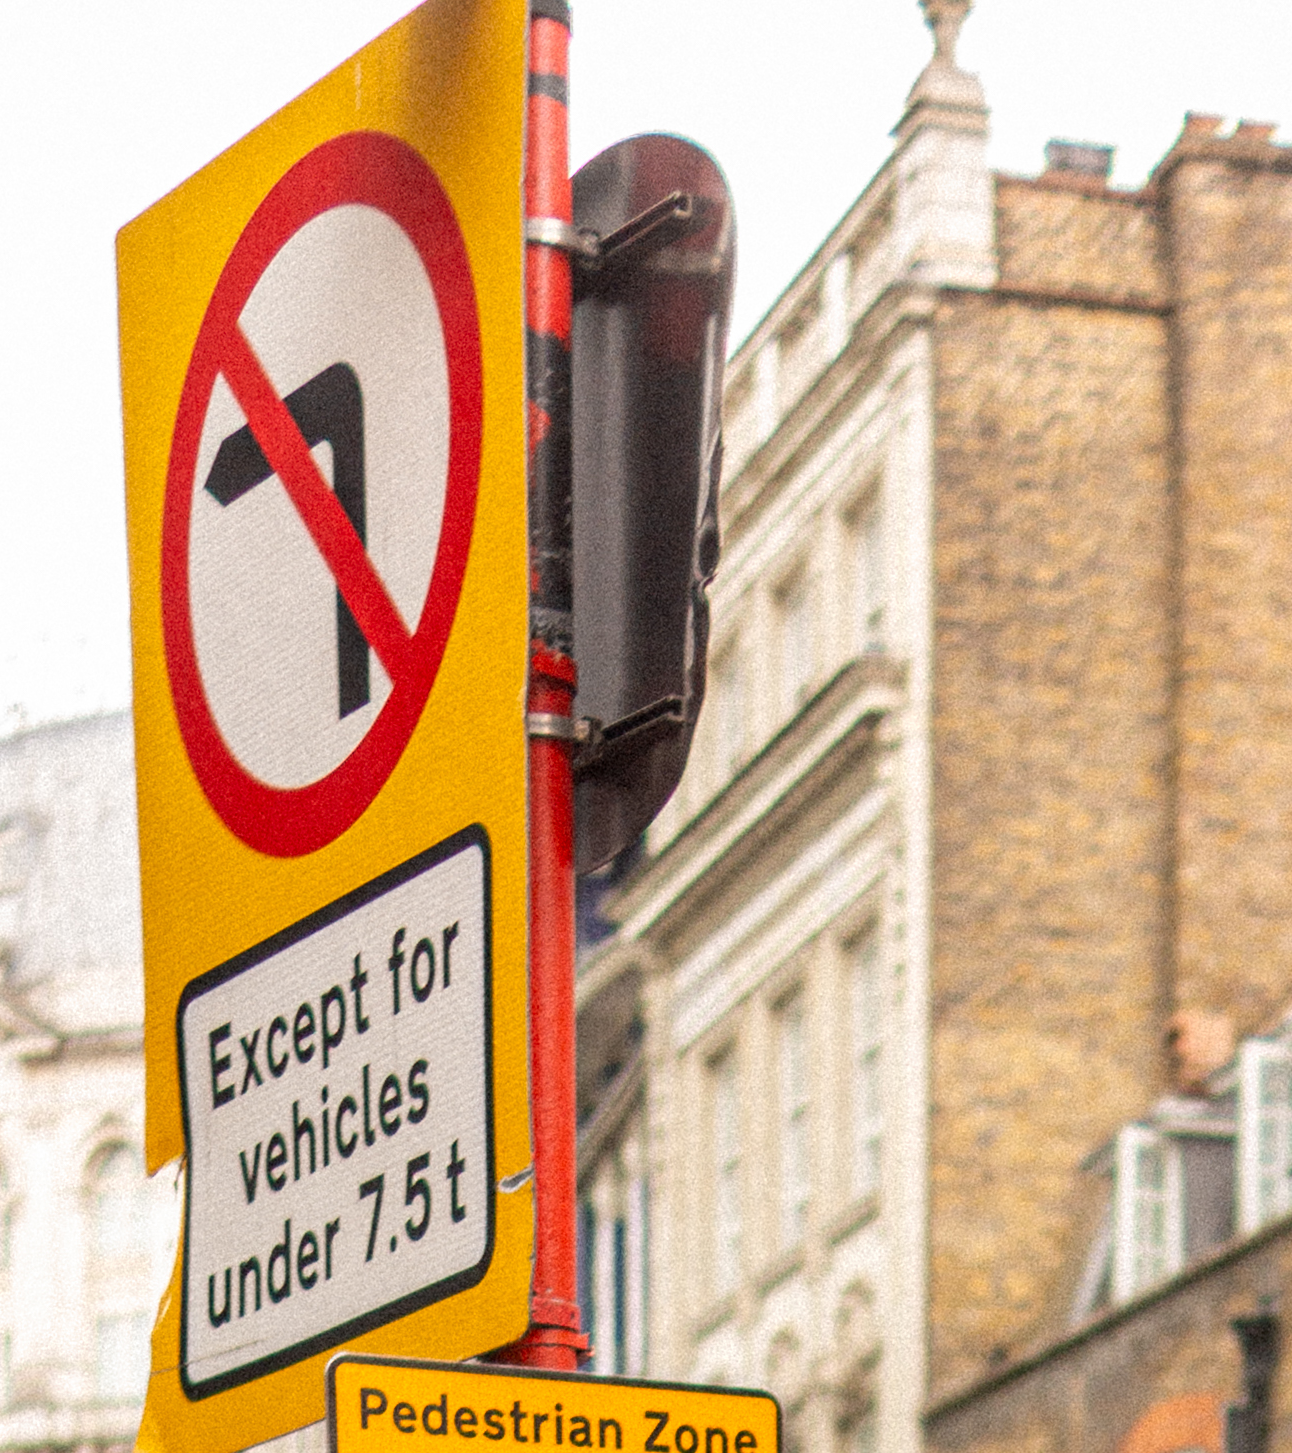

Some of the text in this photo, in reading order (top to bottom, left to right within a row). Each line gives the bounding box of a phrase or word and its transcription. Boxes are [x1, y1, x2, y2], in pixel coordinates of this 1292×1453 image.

[209, 920, 459, 1109] Except for
[239, 1058, 429, 1204] vehicles
[208, 1217, 340, 1328] under
[359, 1388, 623, 1450] Pedestrian
